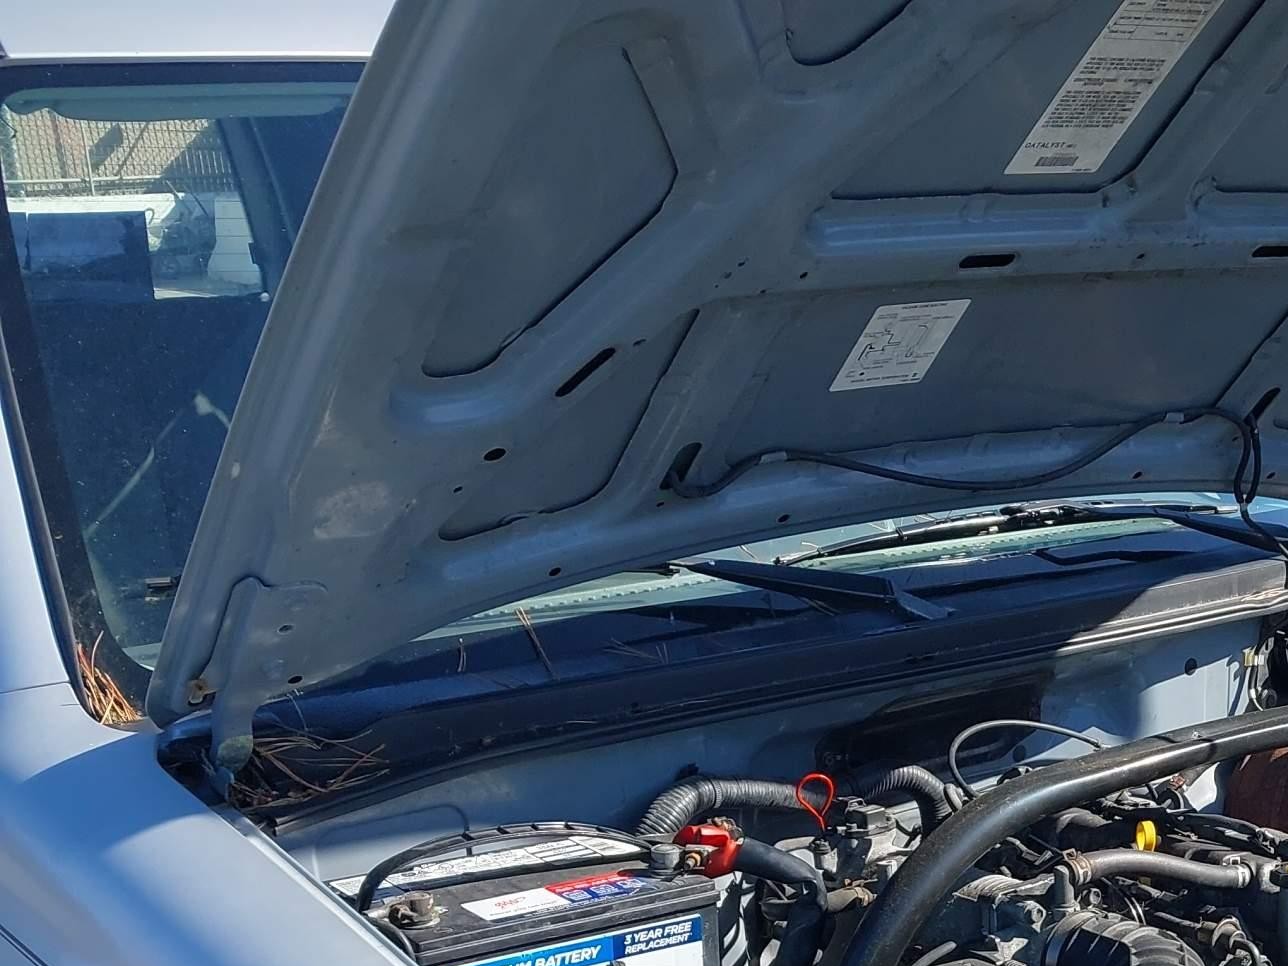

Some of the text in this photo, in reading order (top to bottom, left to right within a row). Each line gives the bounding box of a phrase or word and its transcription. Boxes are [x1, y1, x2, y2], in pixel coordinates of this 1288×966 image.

[624, 921, 693, 945] 3 YEAR FREE
